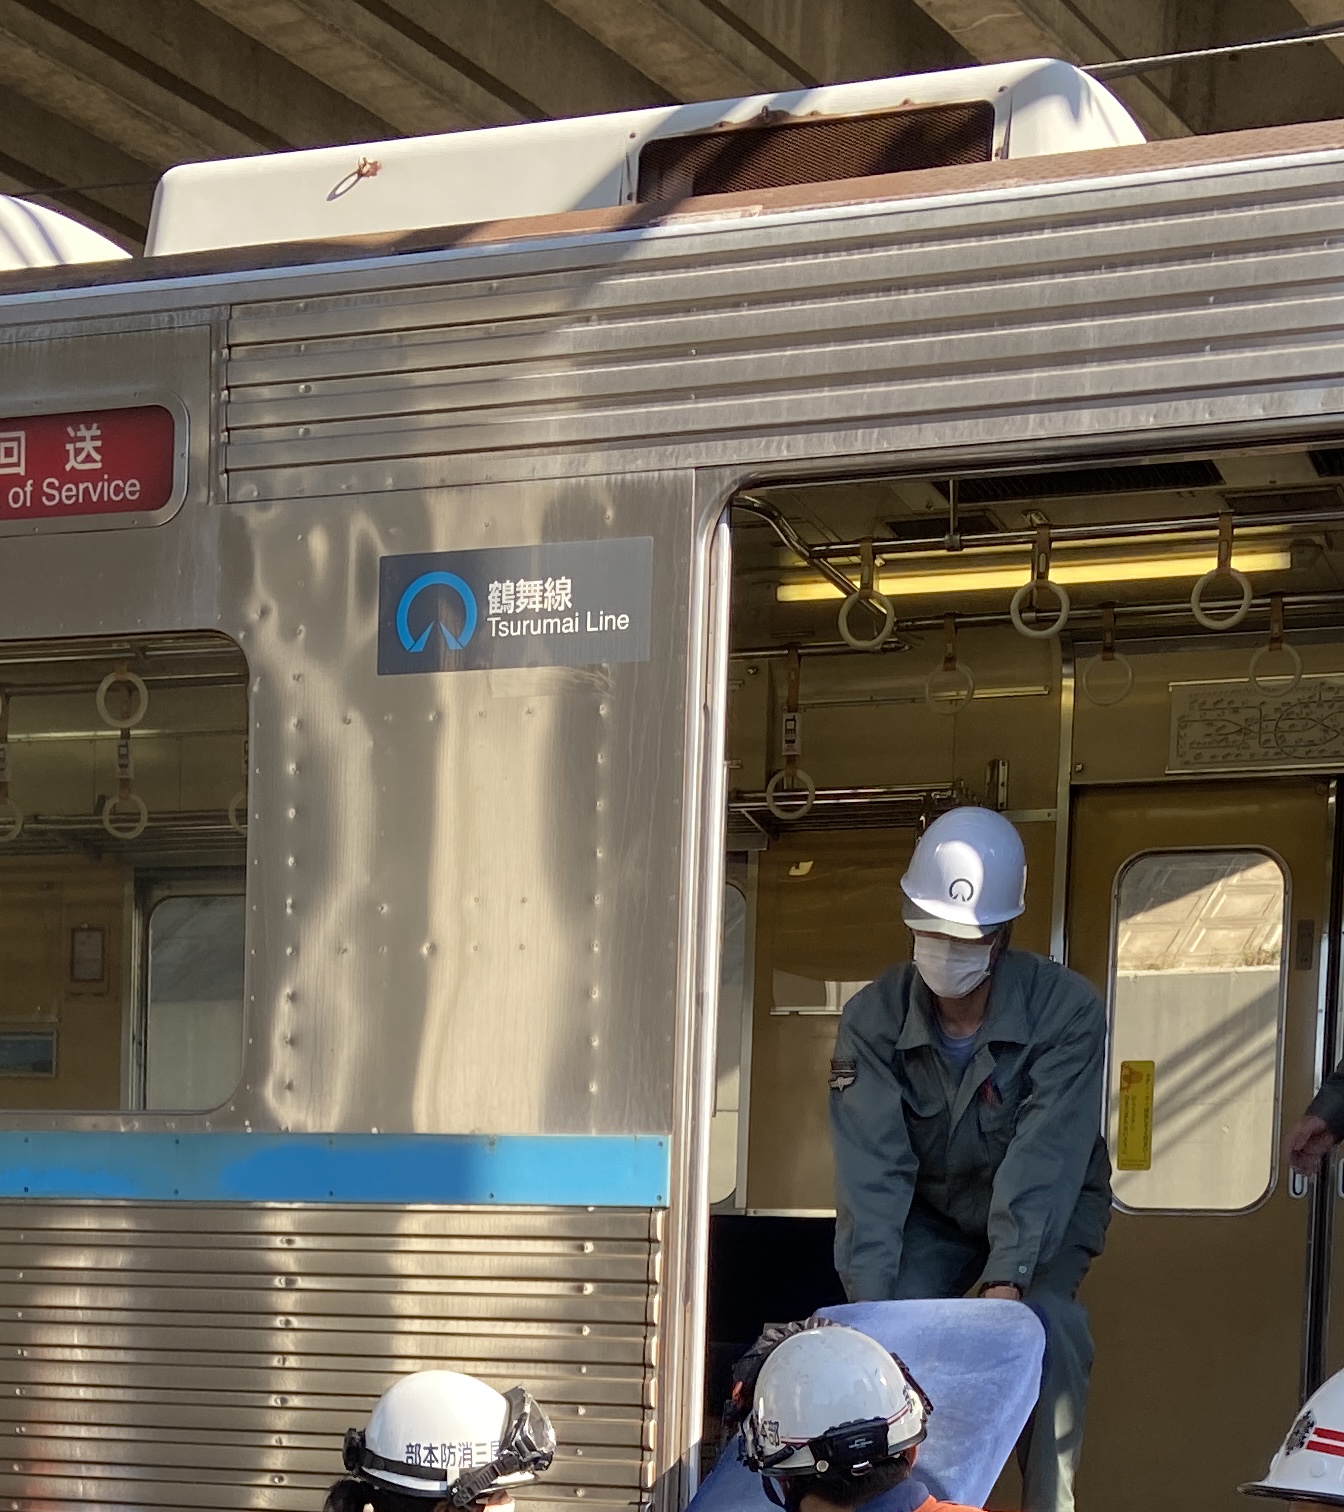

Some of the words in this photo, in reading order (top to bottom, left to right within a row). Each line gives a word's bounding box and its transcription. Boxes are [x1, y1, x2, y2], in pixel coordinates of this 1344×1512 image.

[8, 479, 34, 508] of
[41, 473, 142, 507] Service
[487, 576, 573, 616] 鶴舞線
[486, 611, 580, 638] Tsurumai
[585, 610, 631, 633] Line
